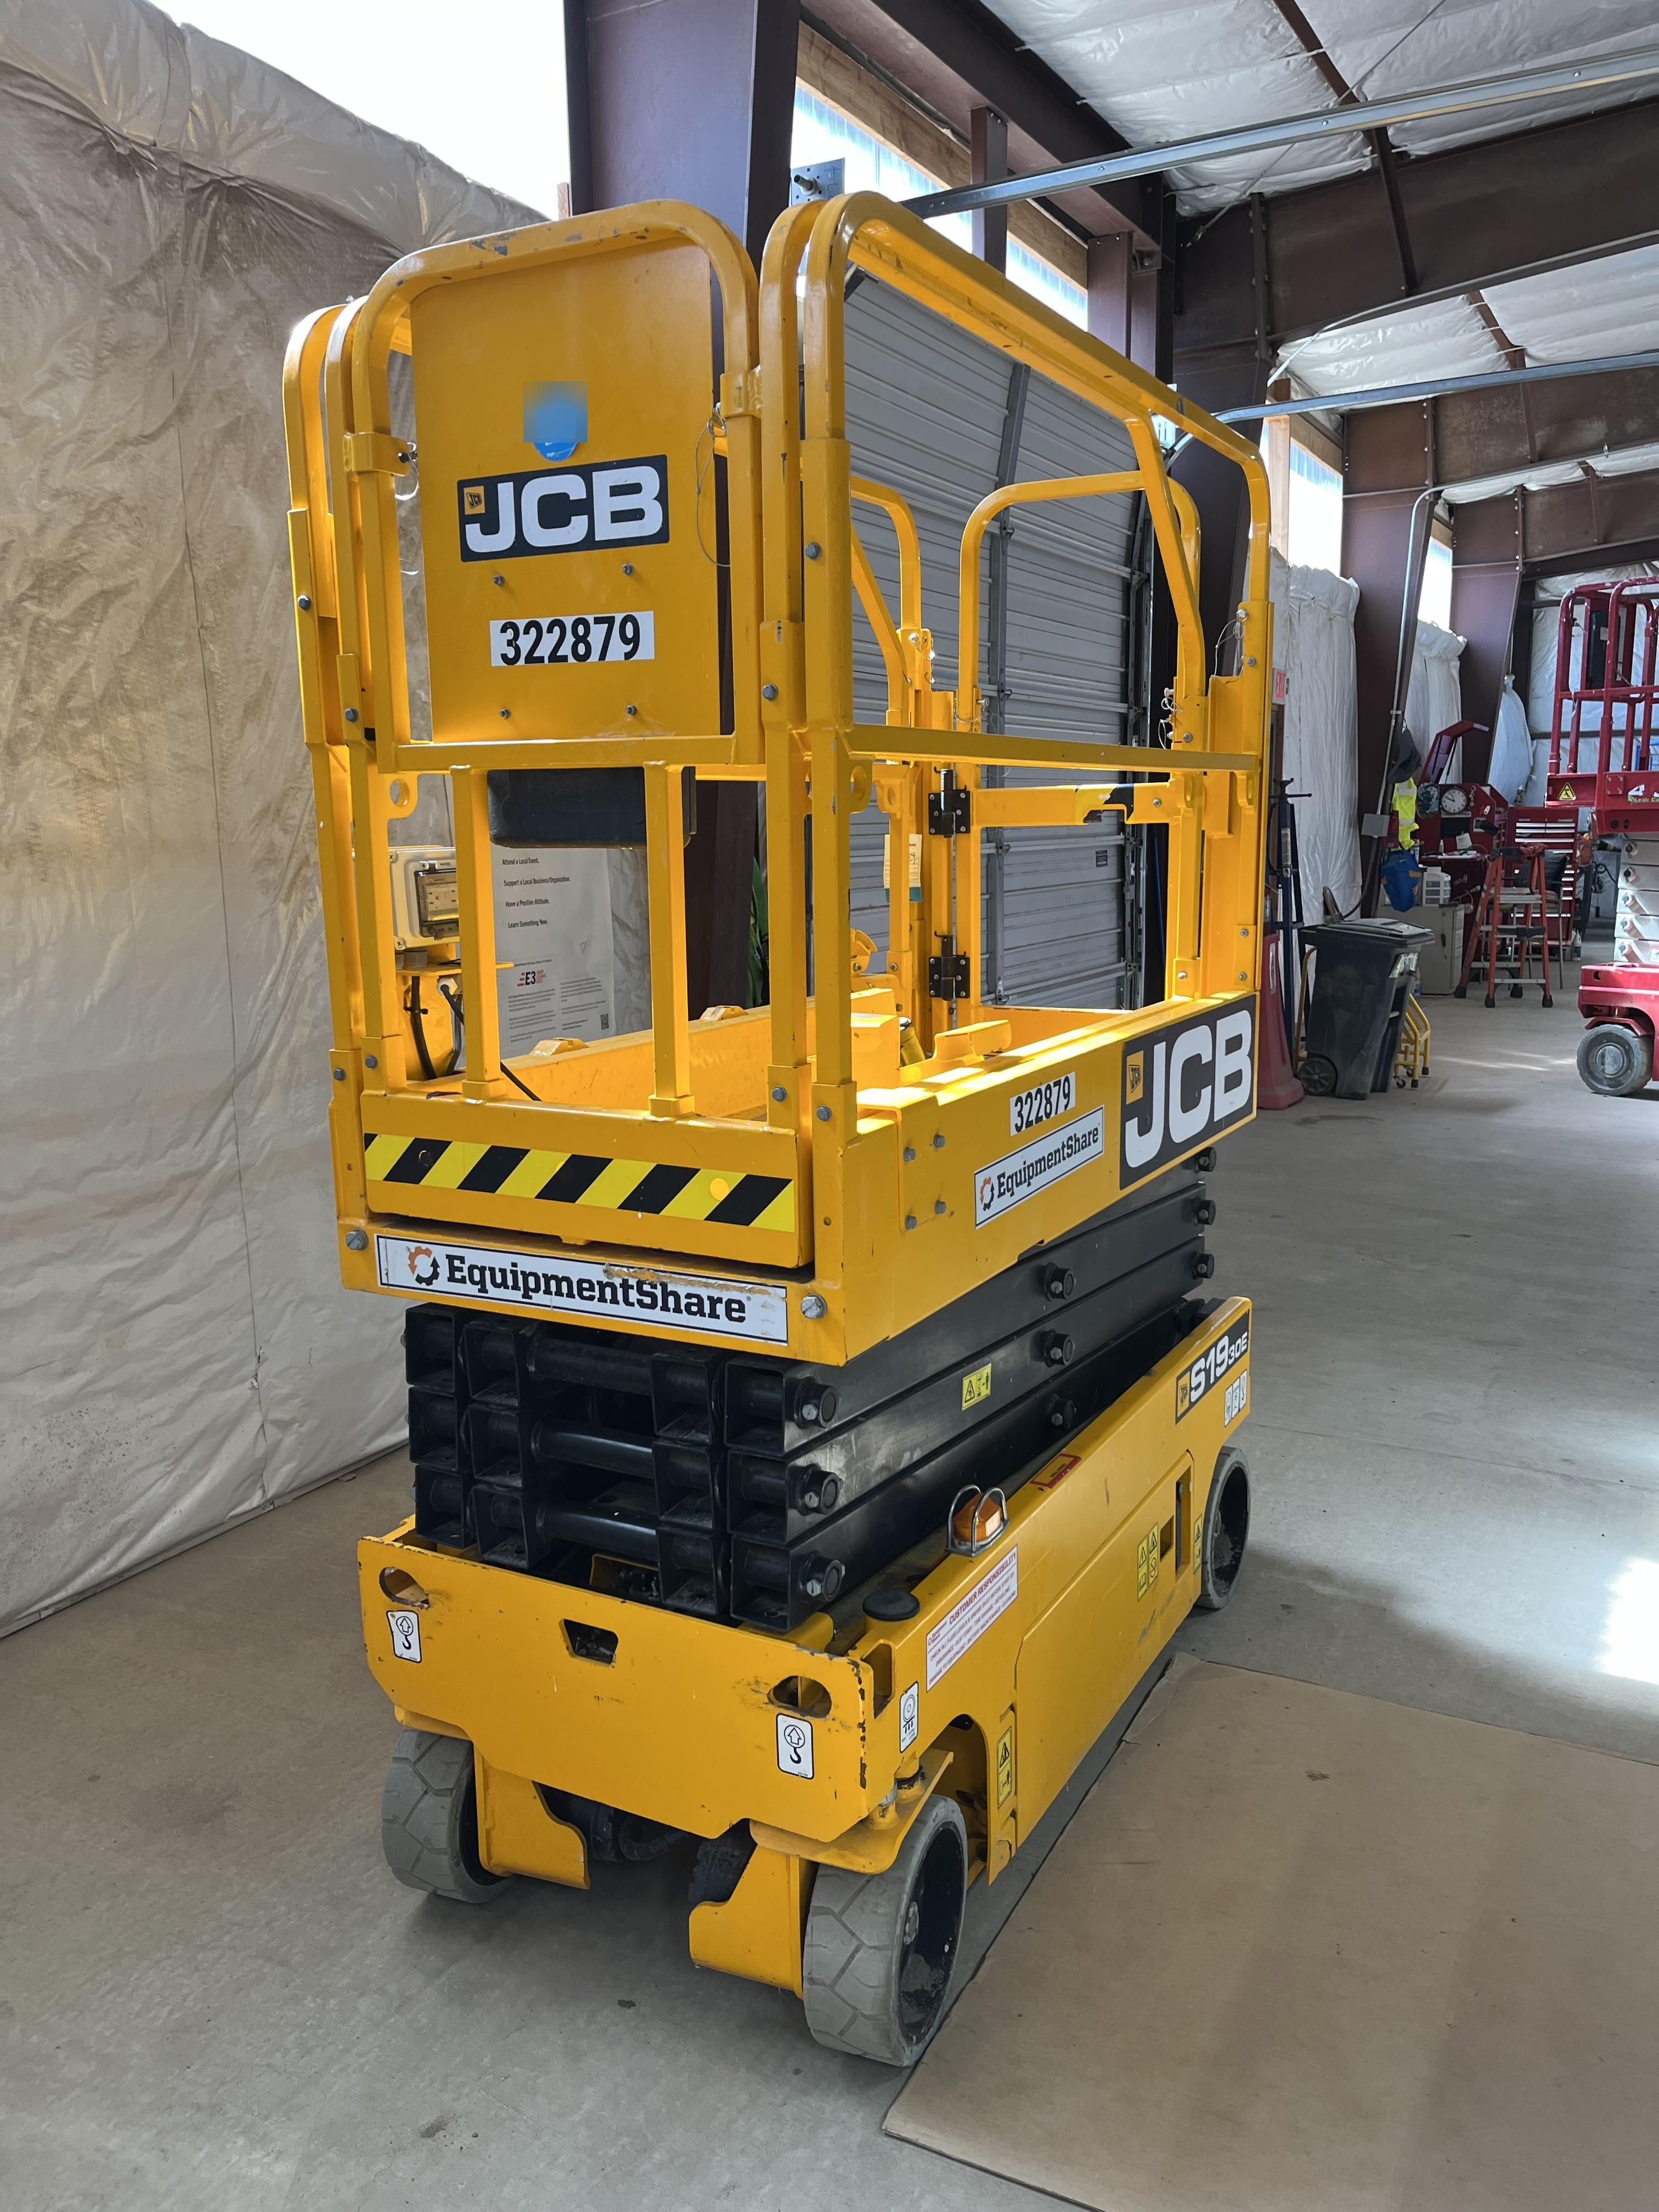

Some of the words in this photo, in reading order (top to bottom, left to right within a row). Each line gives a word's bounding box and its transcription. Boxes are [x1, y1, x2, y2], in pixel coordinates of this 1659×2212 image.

[465, 465, 663, 553] JCB
[499, 613, 640, 665] 322879
[525, 970, 536, 985] E3
[1014, 1076, 1071, 1133] 322879
[1125, 1009, 1252, 1168] JCB
[997, 1126, 1099, 1199] EquipmentShare
[445, 1254, 746, 1323] EquipmentShare
[949, 1591, 977, 1625] CUSTOMER
[978, 1553, 1015, 1596] RESPONSIBILITY
[930, 1647, 940, 1662] CHECK
